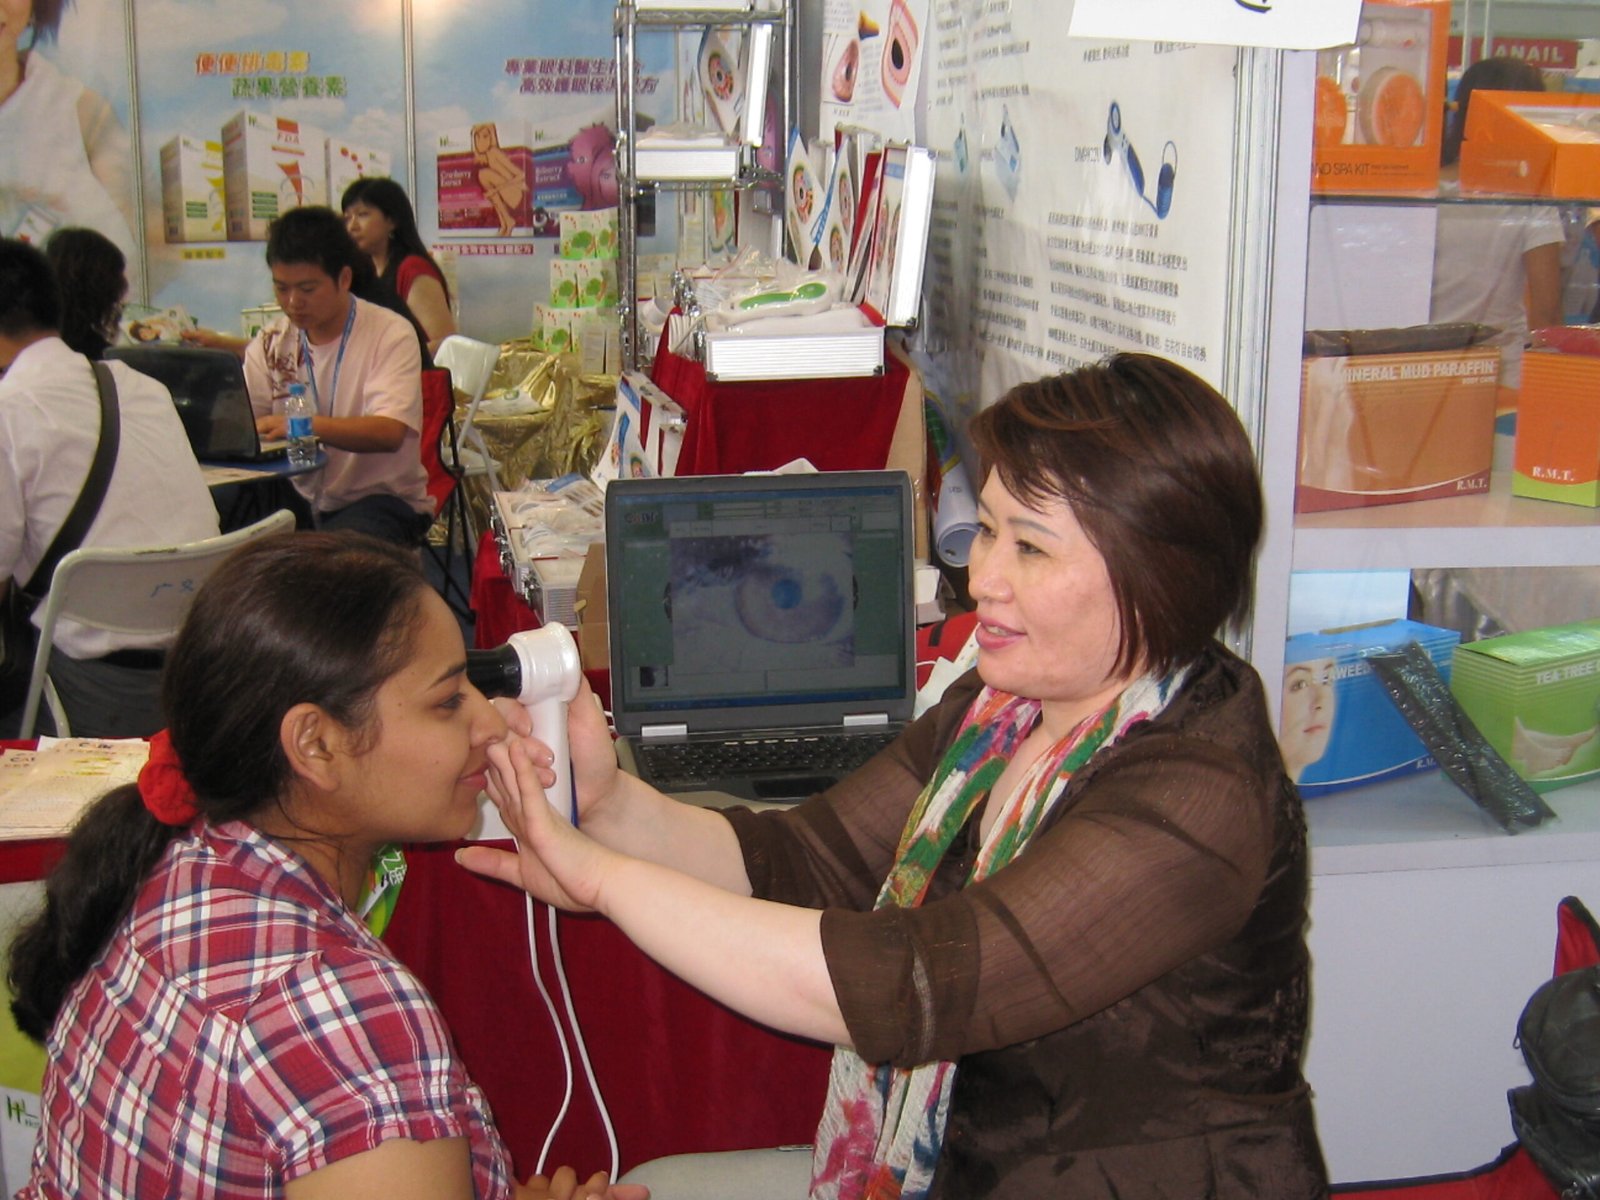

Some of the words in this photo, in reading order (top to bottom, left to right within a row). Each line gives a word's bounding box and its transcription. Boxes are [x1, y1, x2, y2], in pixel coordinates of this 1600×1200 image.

[505, 58, 644, 75] 專業眼科醫生
[519, 76, 659, 94] 高效護眼保方
[1400, 364, 1431, 379] MUD
[1433, 361, 1495, 377] PARAFFIN
[1532, 465, 1575, 481] R.M.T.
[1456, 478, 1488, 490] R.M.T.
[1535, 670, 1564, 685] TEA
[1565, 661, 1597, 680] TREE
